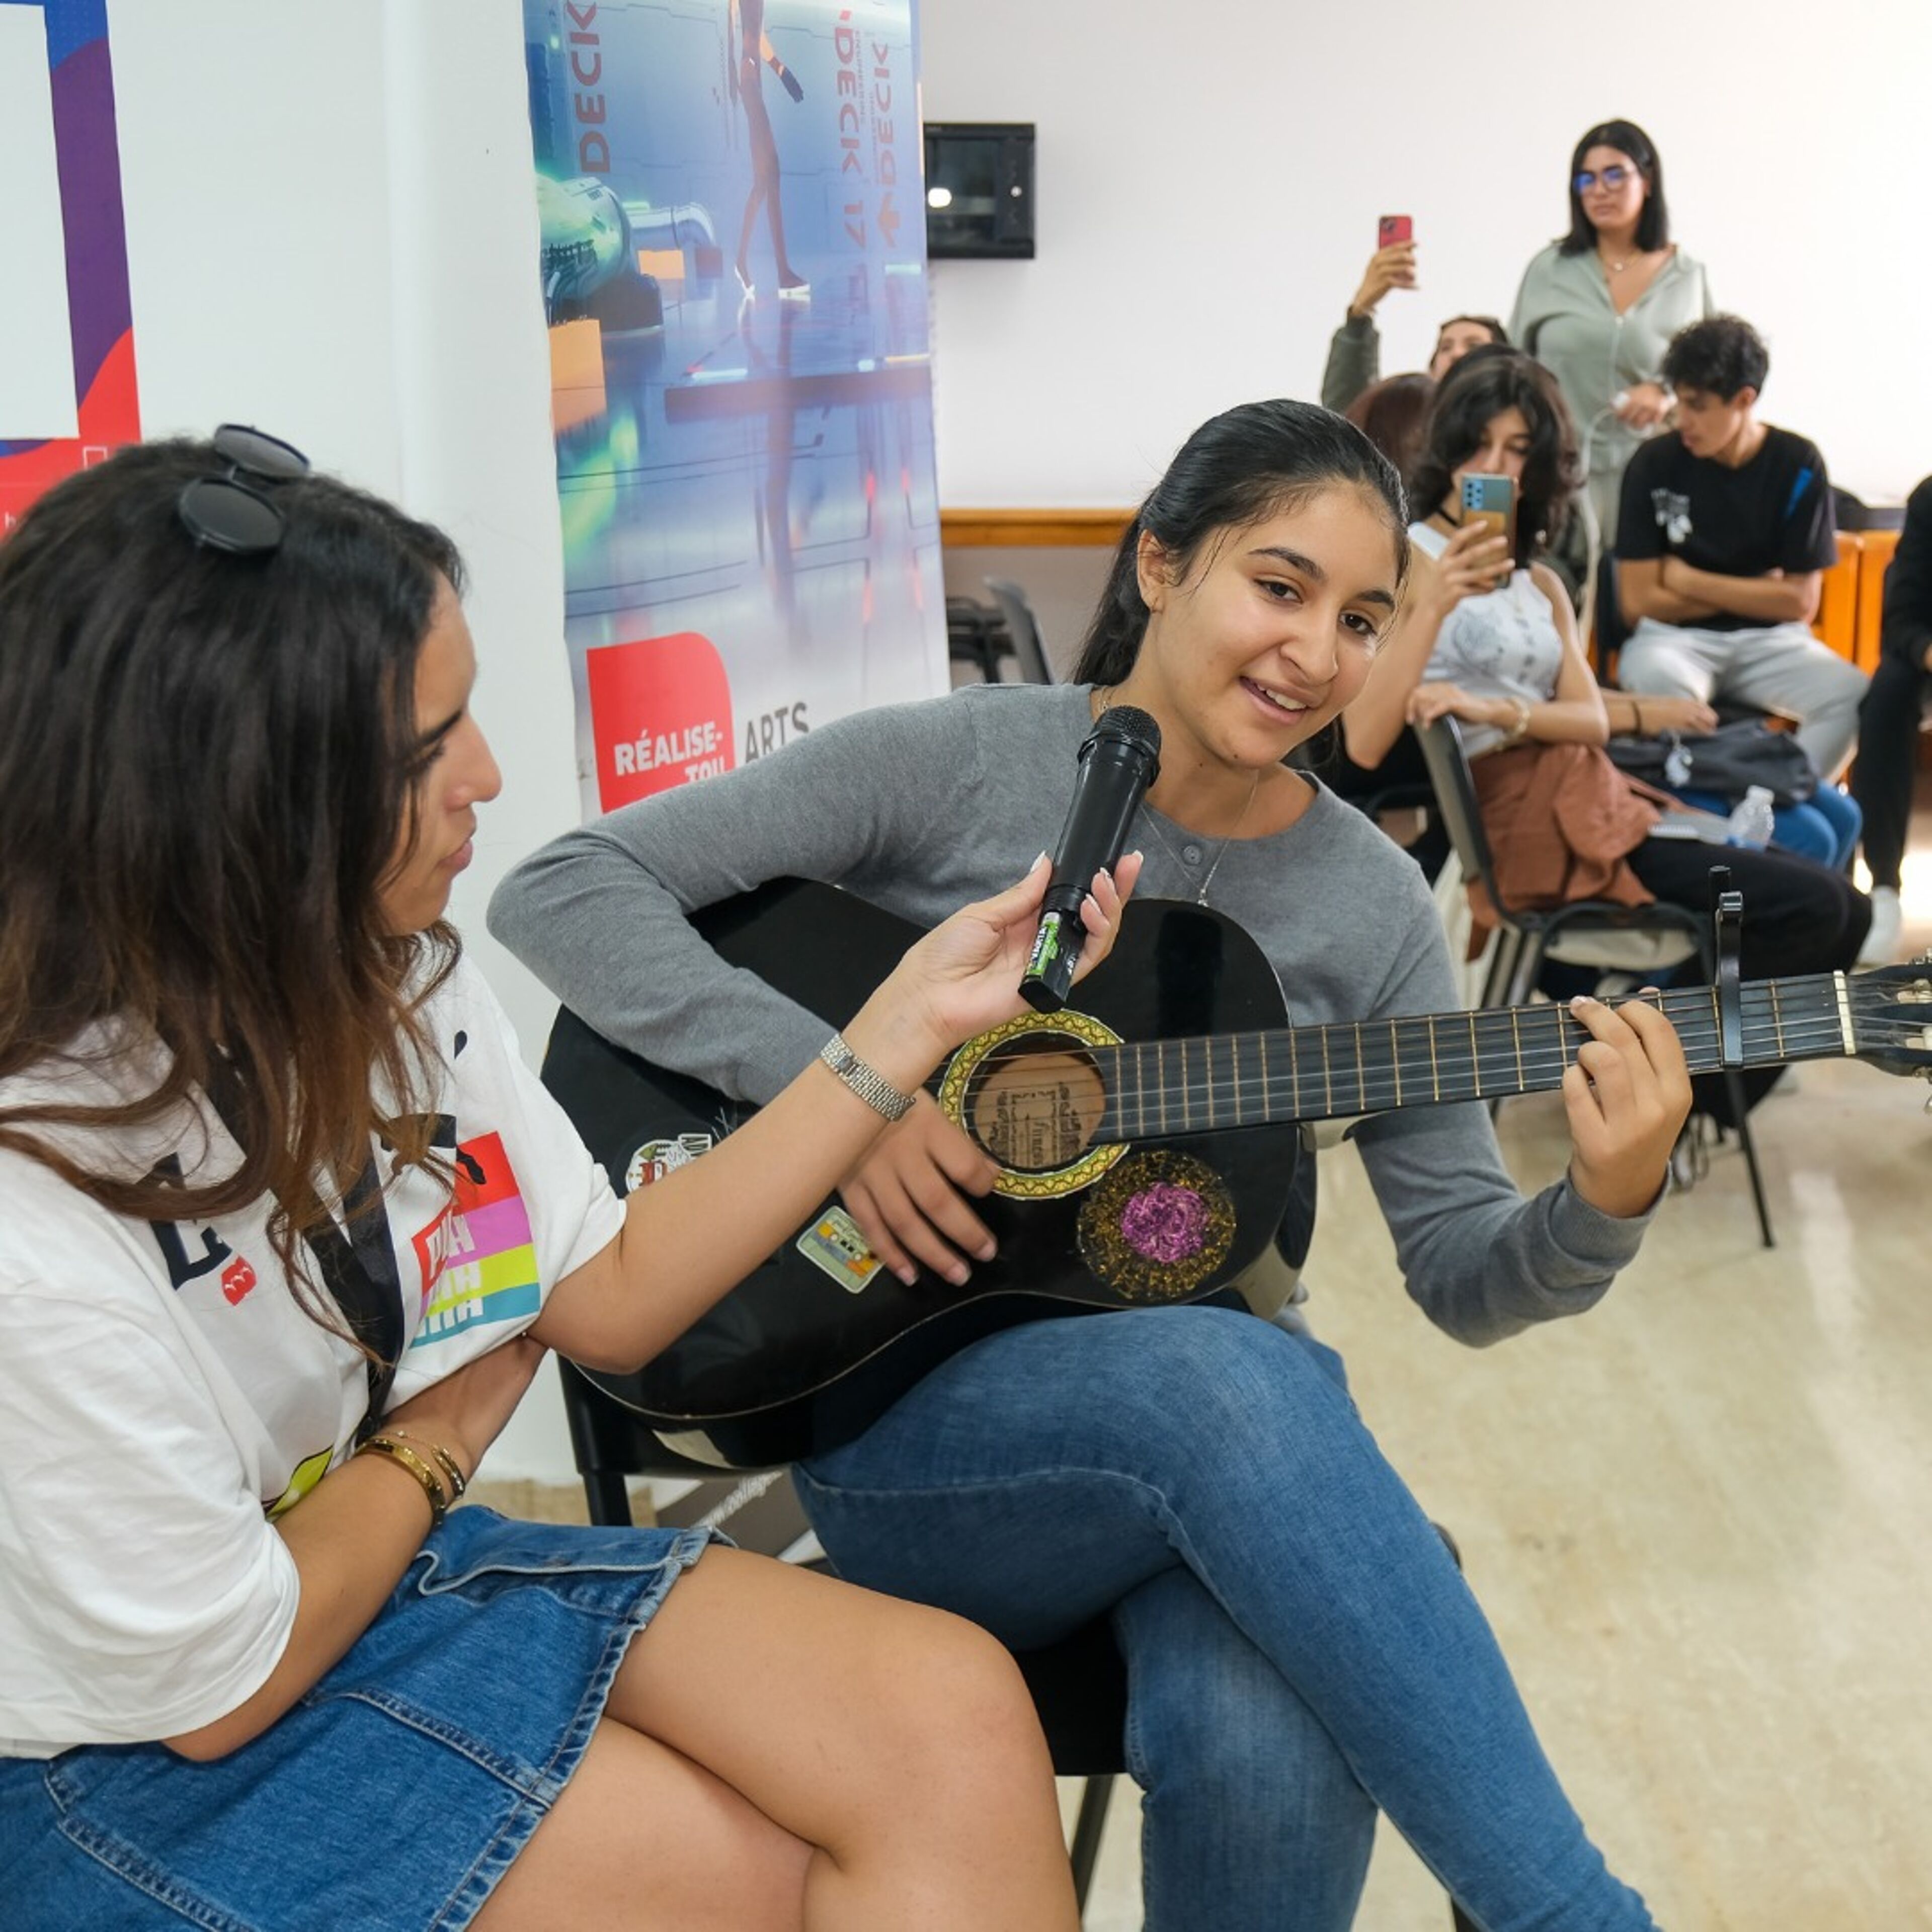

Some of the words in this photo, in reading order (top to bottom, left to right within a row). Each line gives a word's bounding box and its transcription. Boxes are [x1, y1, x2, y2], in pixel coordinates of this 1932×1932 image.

[567, 0, 610, 173] DECK
[835, 26, 862, 174] DECK
[614, 720, 723, 777] RÉALISE-
[745, 701, 810, 764] ARTS
